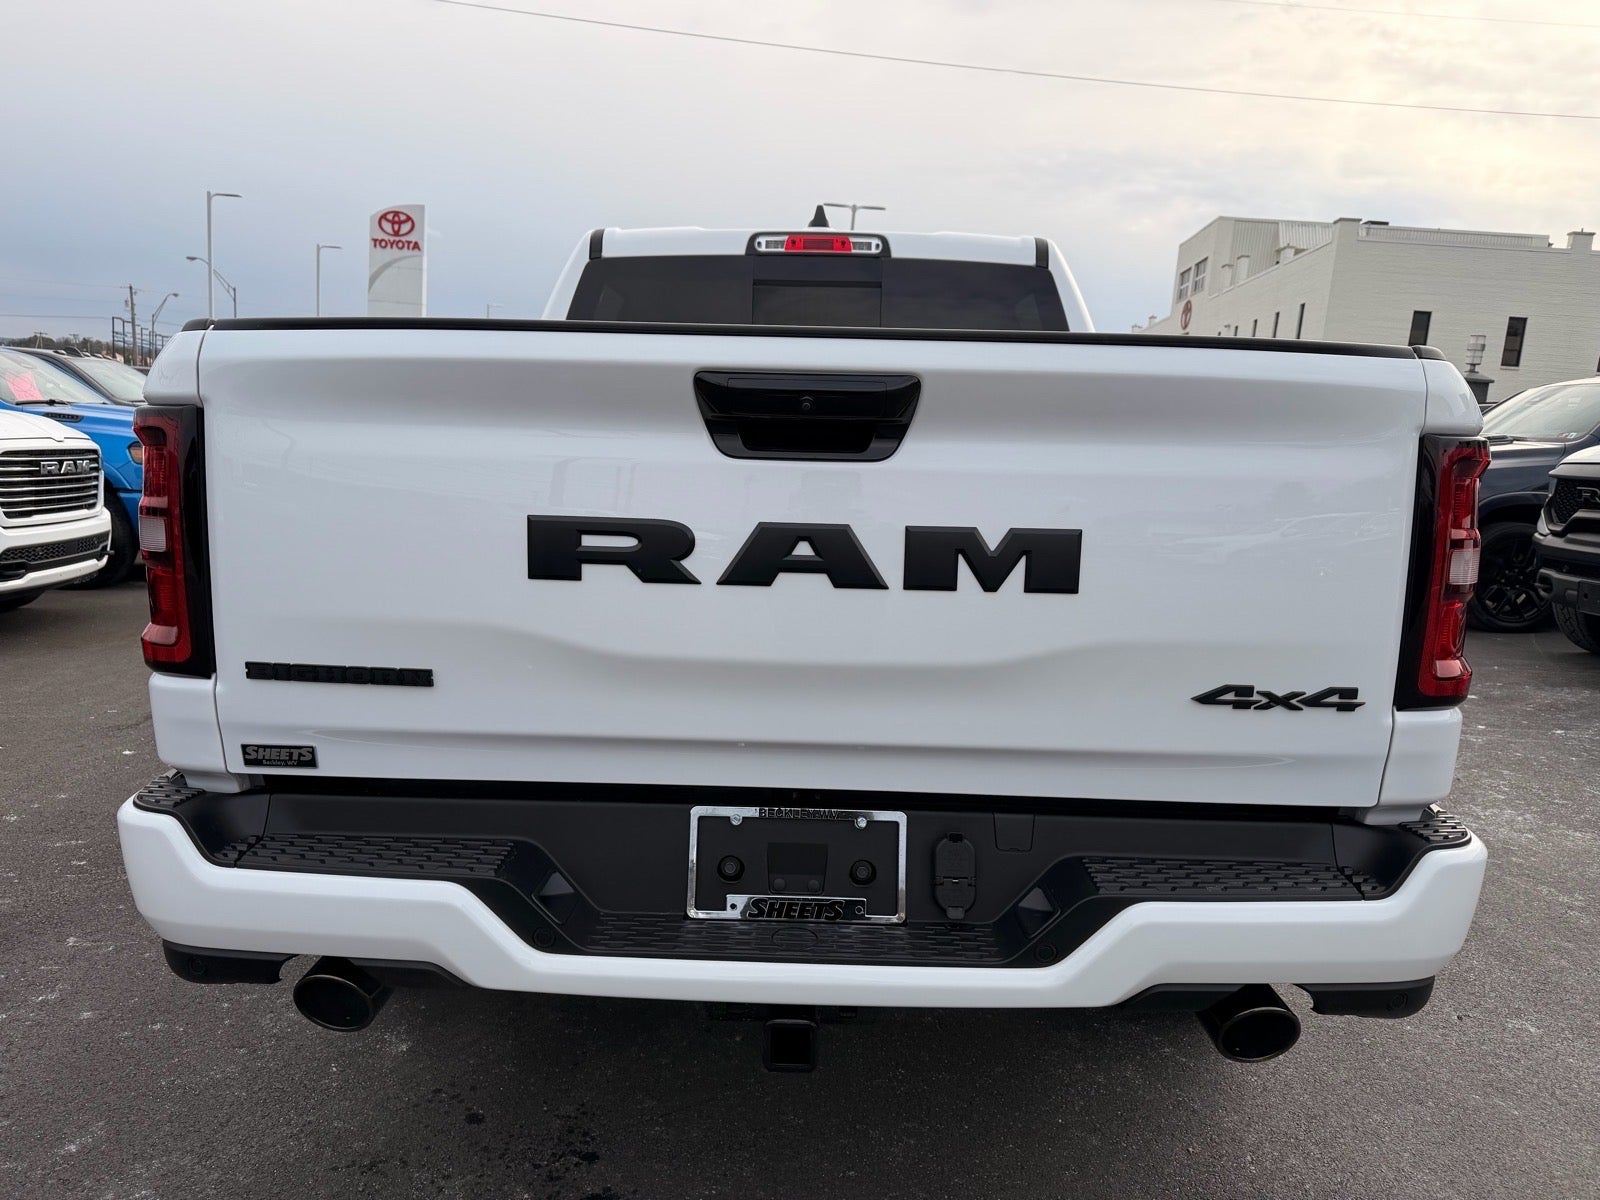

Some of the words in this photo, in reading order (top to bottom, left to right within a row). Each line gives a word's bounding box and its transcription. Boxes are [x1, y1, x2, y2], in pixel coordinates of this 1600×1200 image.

[371, 238, 422, 252] TOYOTA
[40, 460, 90, 475] RAM
[527, 514, 1082, 594] RAM
[244, 746, 313, 761] SHEETS
[747, 897, 846, 920] SHEETS
